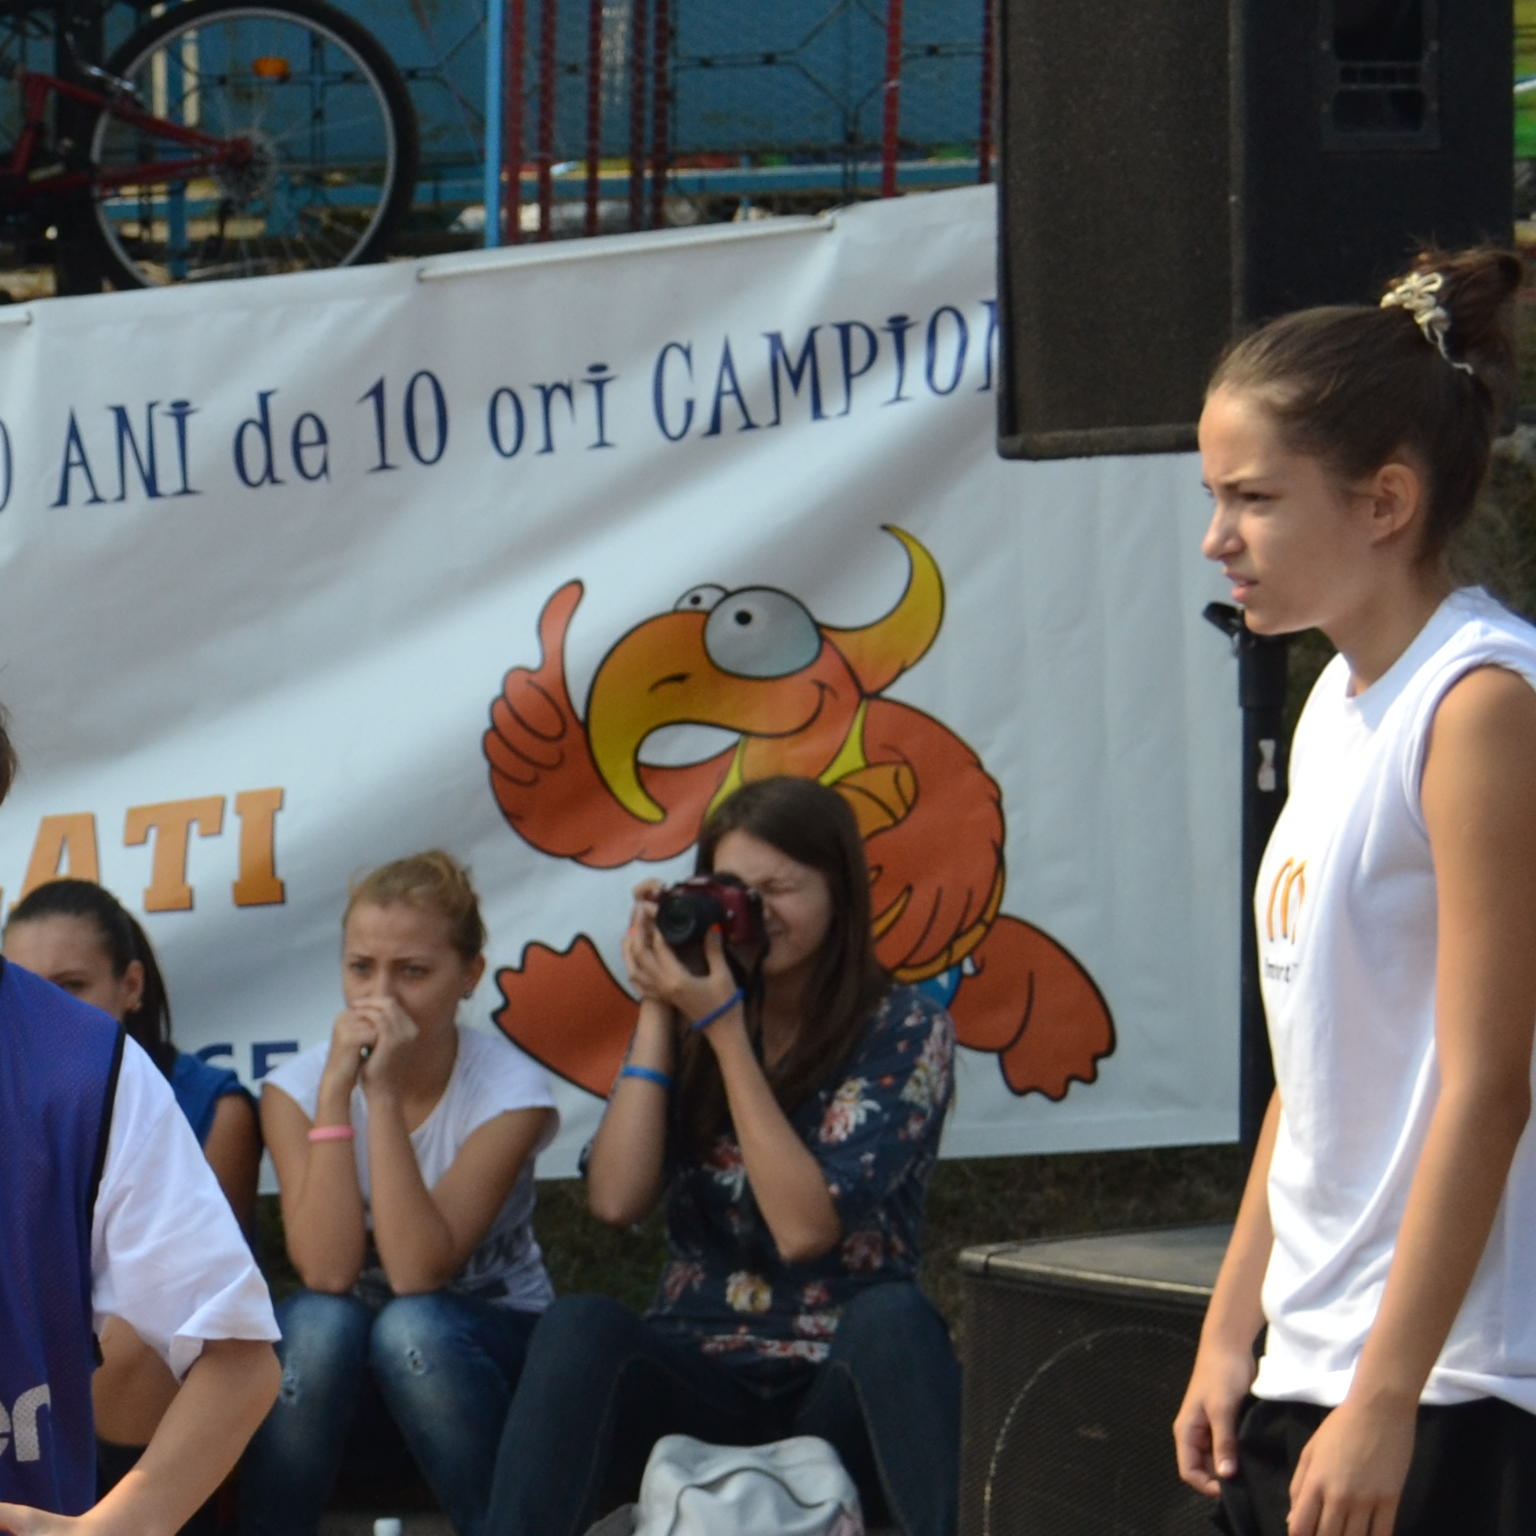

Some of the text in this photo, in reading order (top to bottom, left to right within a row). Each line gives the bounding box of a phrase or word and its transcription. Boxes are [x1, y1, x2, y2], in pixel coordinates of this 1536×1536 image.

[233, 389, 330, 486] de
[357, 369, 449, 474] 10
[487, 363, 620, 459] ori
